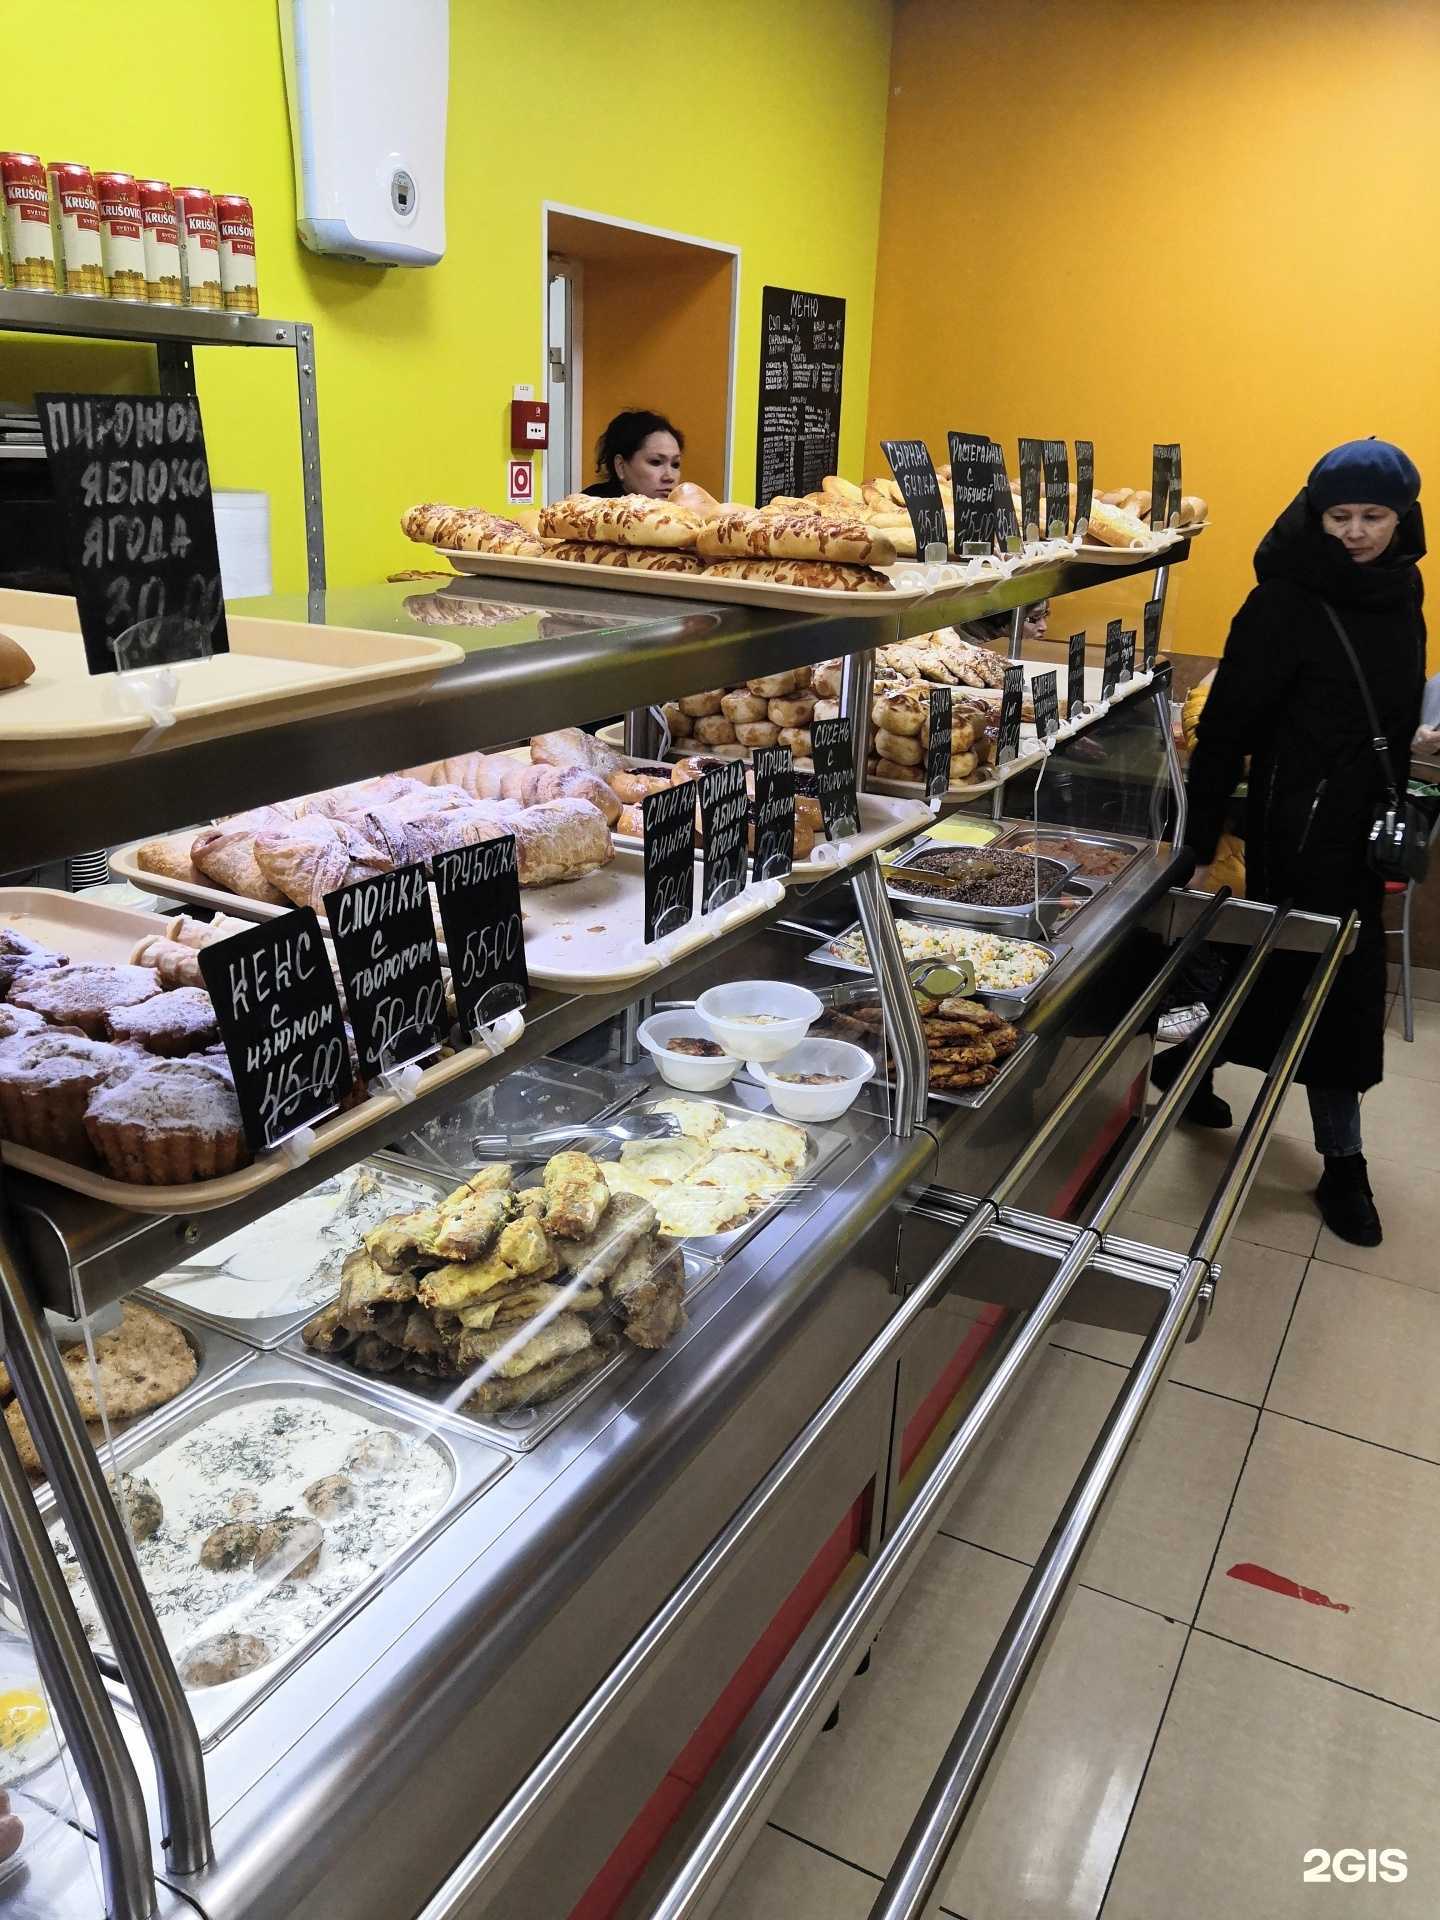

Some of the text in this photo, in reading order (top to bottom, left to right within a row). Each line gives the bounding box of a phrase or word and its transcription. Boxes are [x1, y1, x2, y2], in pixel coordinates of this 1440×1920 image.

[790, 293, 819, 318] МЕНЮ
[81, 457, 208, 507] ЯБЛОКО
[887, 442, 929, 472] СЫРНАЯ
[903, 473, 936, 497] БУЛКА
[82, 513, 193, 568] ЯГОДА
[646, 784, 696, 831] СЛОЙКА
[703, 762, 745, 809] СЛОЙКА
[710, 793, 748, 835] ЯБЛОКО
[649, 819, 693, 869] ВИШНЯ
[708, 823, 741, 861] ЯГОДА
[337, 868, 427, 937] СЛОЙКА
[370, 929, 388, 958] С
[461, 914, 522, 987] 55-00
[229, 929, 316, 1021] КЕКС
[351, 938, 433, 1000] ТВОРОГОМ
[247, 1003, 333, 1073] ИЗЮМОМ
[270, 1003, 288, 1028] С
[366, 978, 444, 1063] 50-00
[259, 1037, 343, 1126] 45-00
